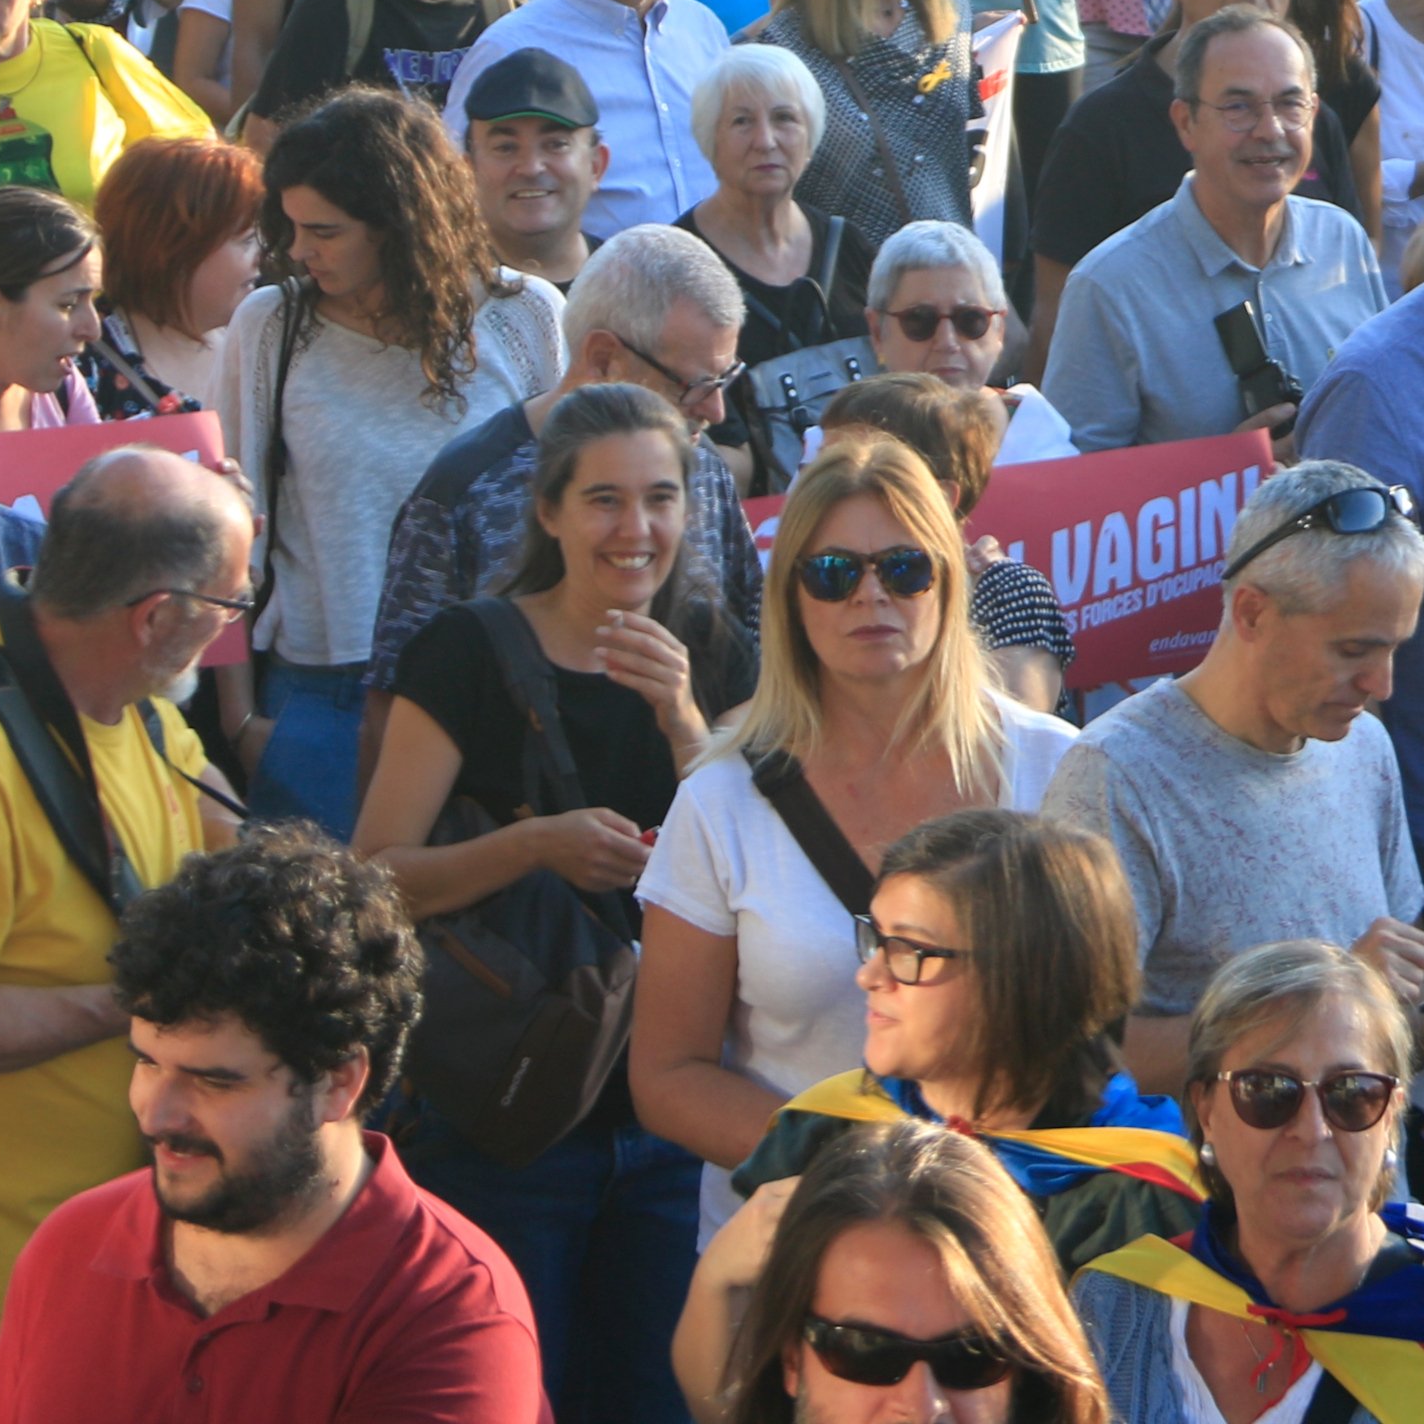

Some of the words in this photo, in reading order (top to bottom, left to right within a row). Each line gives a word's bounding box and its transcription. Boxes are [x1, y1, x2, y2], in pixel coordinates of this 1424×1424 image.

[1081, 586, 1143, 630] FORCES
[1145, 560, 1226, 608] D'OCUPAC
[1149, 629, 1216, 653] endavan
